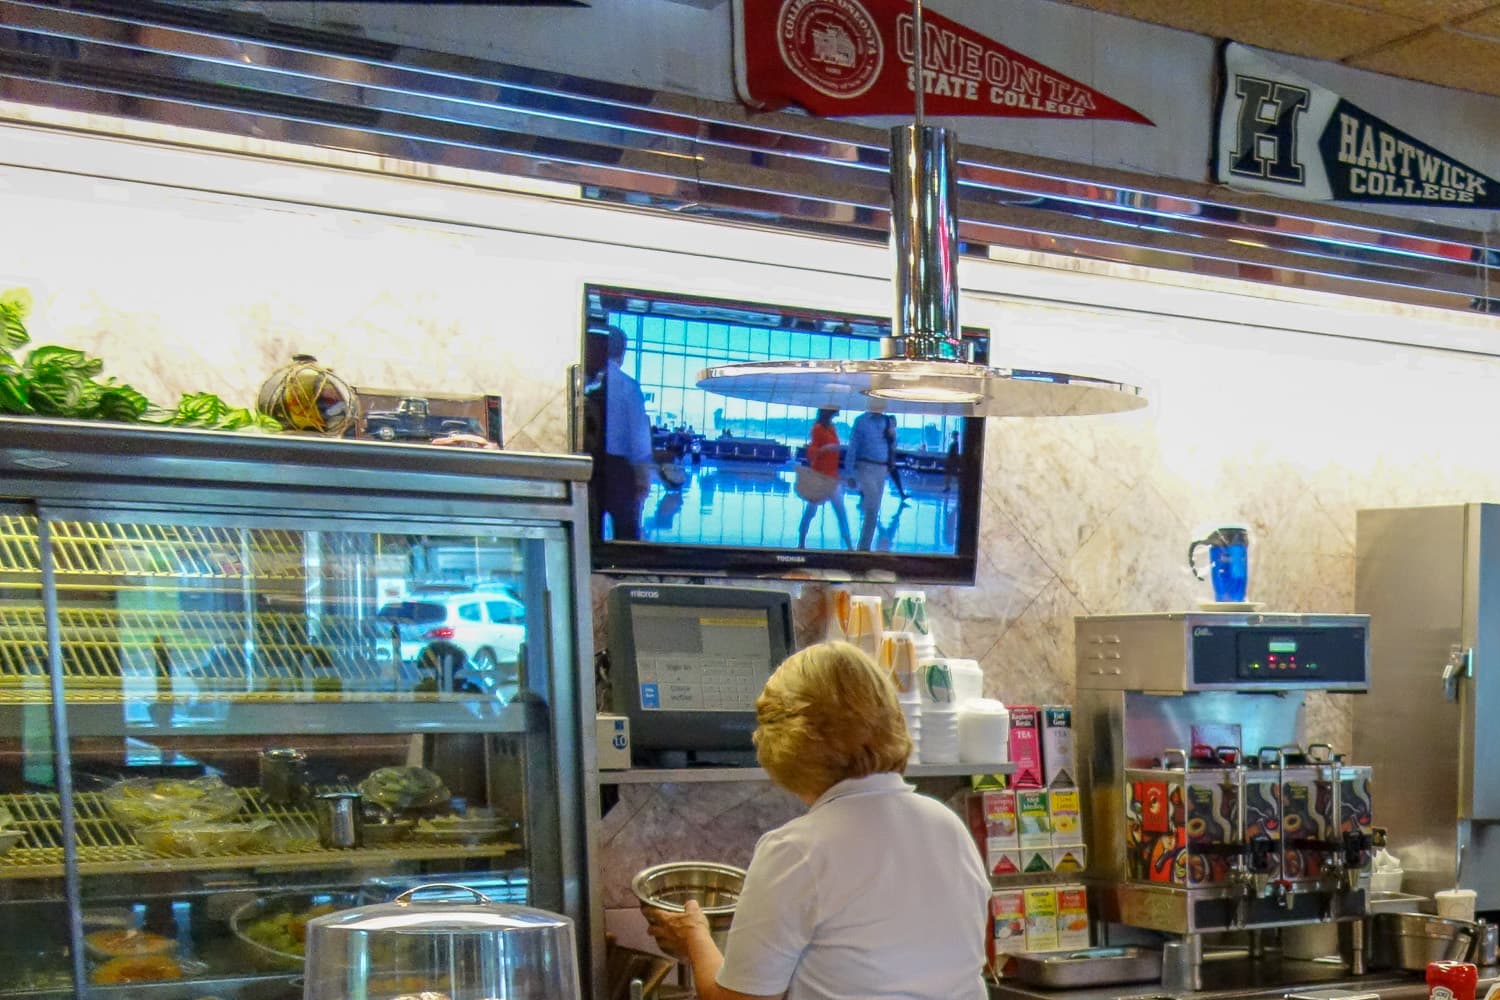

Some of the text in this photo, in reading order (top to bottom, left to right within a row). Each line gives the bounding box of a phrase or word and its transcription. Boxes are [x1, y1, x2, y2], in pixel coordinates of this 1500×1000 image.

[896, 13, 1096, 110] ONEONTA
[907, 65, 978, 100] STATE
[990, 87, 1085, 117] COLLEGE
[1228, 73, 1310, 186] H
[1338, 113, 1488, 197] HARTWICK
[1350, 167, 1476, 204] COLLEGE
